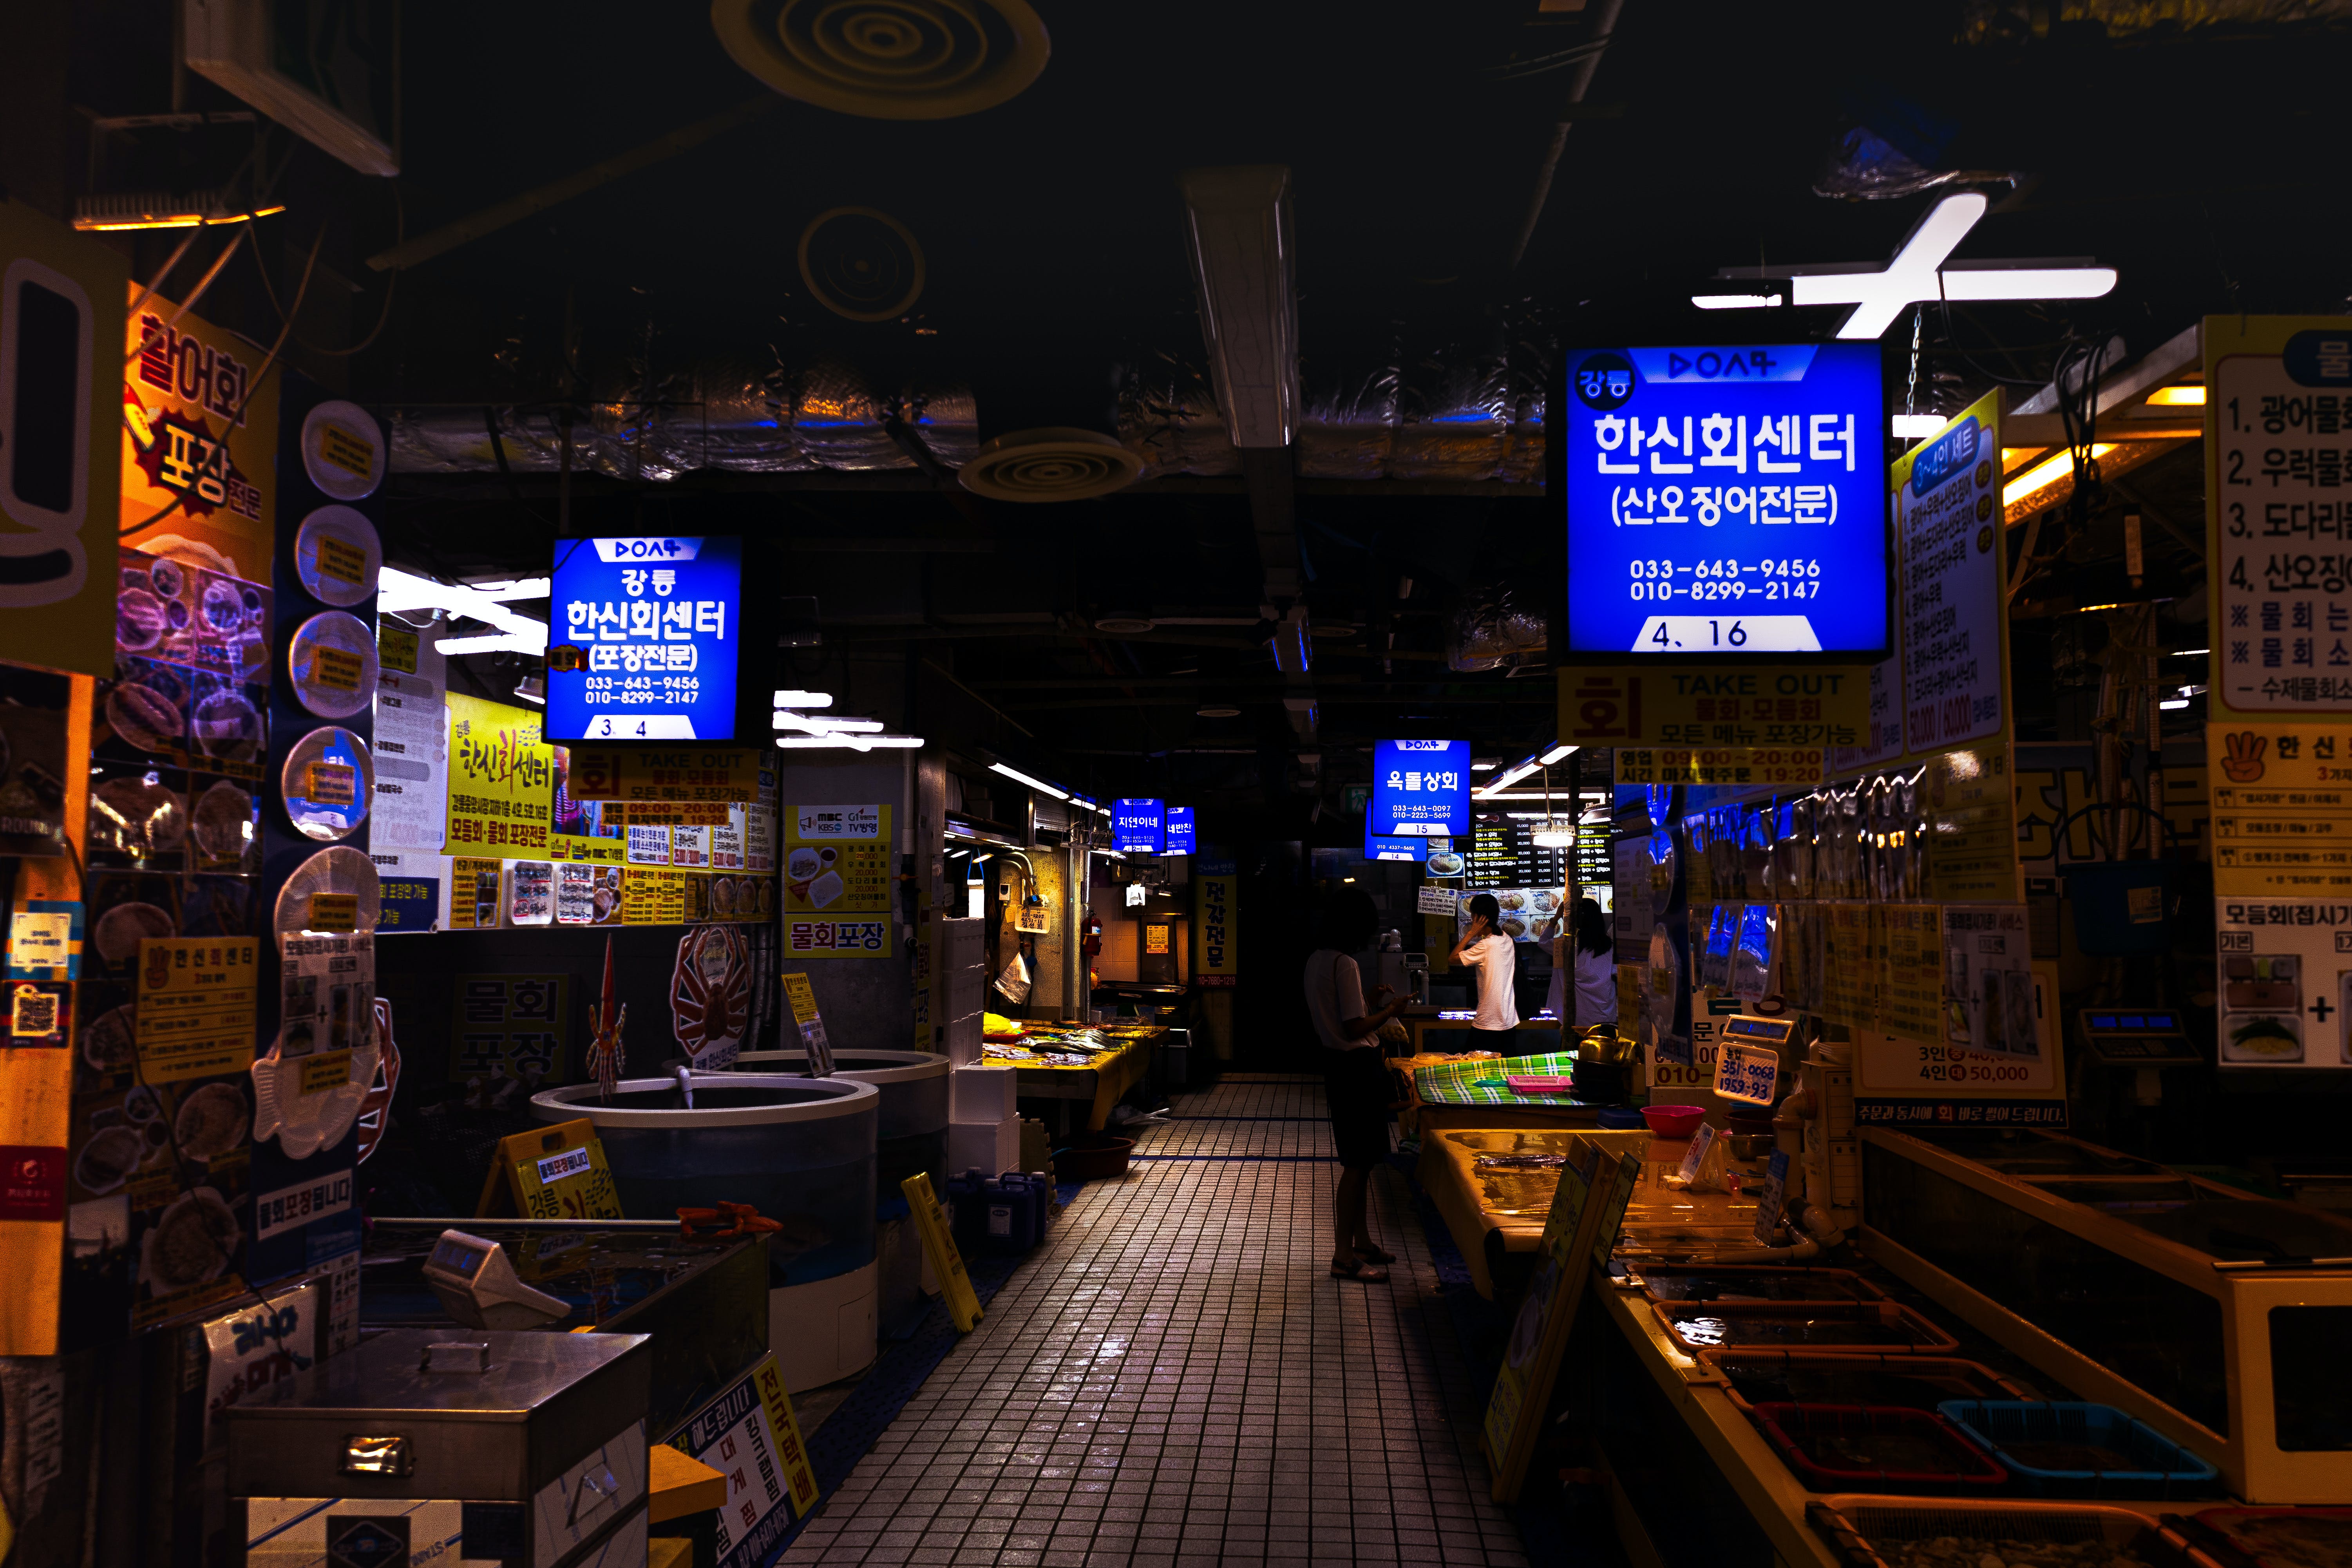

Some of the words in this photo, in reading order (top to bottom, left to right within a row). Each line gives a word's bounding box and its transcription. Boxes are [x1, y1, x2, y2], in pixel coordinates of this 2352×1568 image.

[139, 313, 248, 427] 활어회
[1579, 370, 1630, 399] 강릉
[2229, 398, 2250, 432] 1.
[1594, 413, 1856, 475] 한신회센터
[161, 421, 230, 506] 포장
[2229, 450, 2251, 485] 2.
[1612, 484, 1838, 527] (산오징어전문)
[2229, 503, 2252, 538] 3.
[2263, 502, 2352, 539] 도다리
[1630, 559, 1820, 579] 033-643-9456
[2229, 557, 2252, 591] 4.
[621, 569, 676, 597] 강릉
[1630, 581, 1820, 601] 010-8299-2147
[567, 600, 726, 640] 한신회센터
[1710, 620, 1747, 646] 16
[589, 643, 698, 673] (포장전문)
[586, 677, 699, 689] 033-643-9456
[1672, 675, 1757, 694] TAKE
[1776, 675, 1844, 694] OUT
[585, 691, 698, 704] 010-8299-2147
[1573, 677, 1641, 739] 회
[636, 721, 646, 736] 4
[1660, 725, 1706, 743] 모든
[1713, 725, 1758, 743] 메뉴
[1765, 724, 1857, 744] 포장가능
[460, 729, 548, 794] 한신회센터
[639, 754, 692, 767] TAKE
[702, 754, 742, 767] OUT
[1621, 751, 1652, 765] 영업
[579, 755, 621, 795] 회
[1387, 770, 1458, 792] 옥돌상회
[1621, 768, 1653, 783] 시간
[1764, 769, 1820, 782] 19:20
[631, 787, 660, 799] 모든
[664, 787, 691, 800] 메뉴
[695, 787, 750, 801] 포장가능
[604, 815, 624, 825] 시간
[690, 815, 727, 825] 19:20
[818, 813, 842, 821] MBC
[1119, 817, 1157, 828] 지연이네
[849, 823, 877, 833] TV방영
[791, 922, 884, 950] 물회포장
[1195, 976, 1236, 986] 010-7680-1219
[462, 979, 559, 1024] 물회
[459, 1031, 559, 1076] 포장
[1726, 1047, 1742, 1060] 농협
[1919, 1047, 1945, 1061] 3인
[1721, 1060, 1775, 1080] 351-0068
[1920, 1065, 1946, 1080] 4인
[1970, 1067, 2028, 1082] 50,000
[1858, 1105, 1894, 1120] 주문과
[1896, 1106, 1933, 1120] 동시에
[1936, 1103, 1956, 1123] 회
[1958, 1107, 1984, 1121] 바로
[1985, 1106, 2009, 1121] 썰어
[2011, 1106, 2064, 1122] 드립니다.
[760, 1366, 812, 1505] 전국택배
